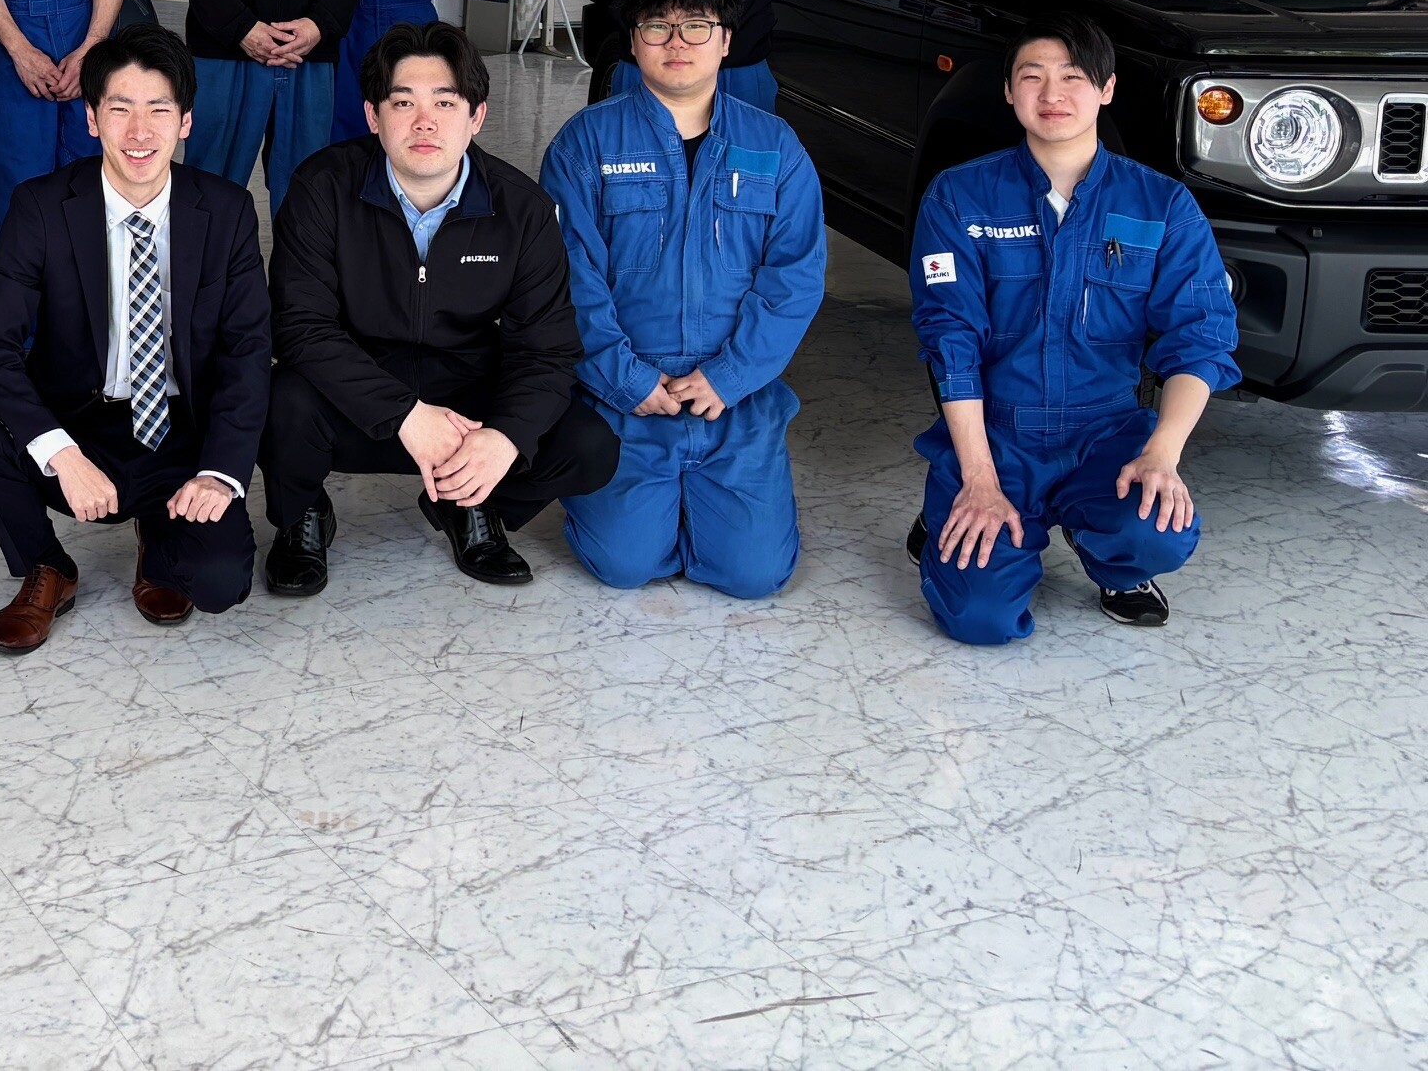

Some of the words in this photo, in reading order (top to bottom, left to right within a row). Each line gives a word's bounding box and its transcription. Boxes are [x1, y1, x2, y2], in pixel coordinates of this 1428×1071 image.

[602, 162, 657, 176] SUZUKI
[984, 224, 1041, 239] SUZUKI
[465, 255, 499, 263] SUZUKI
